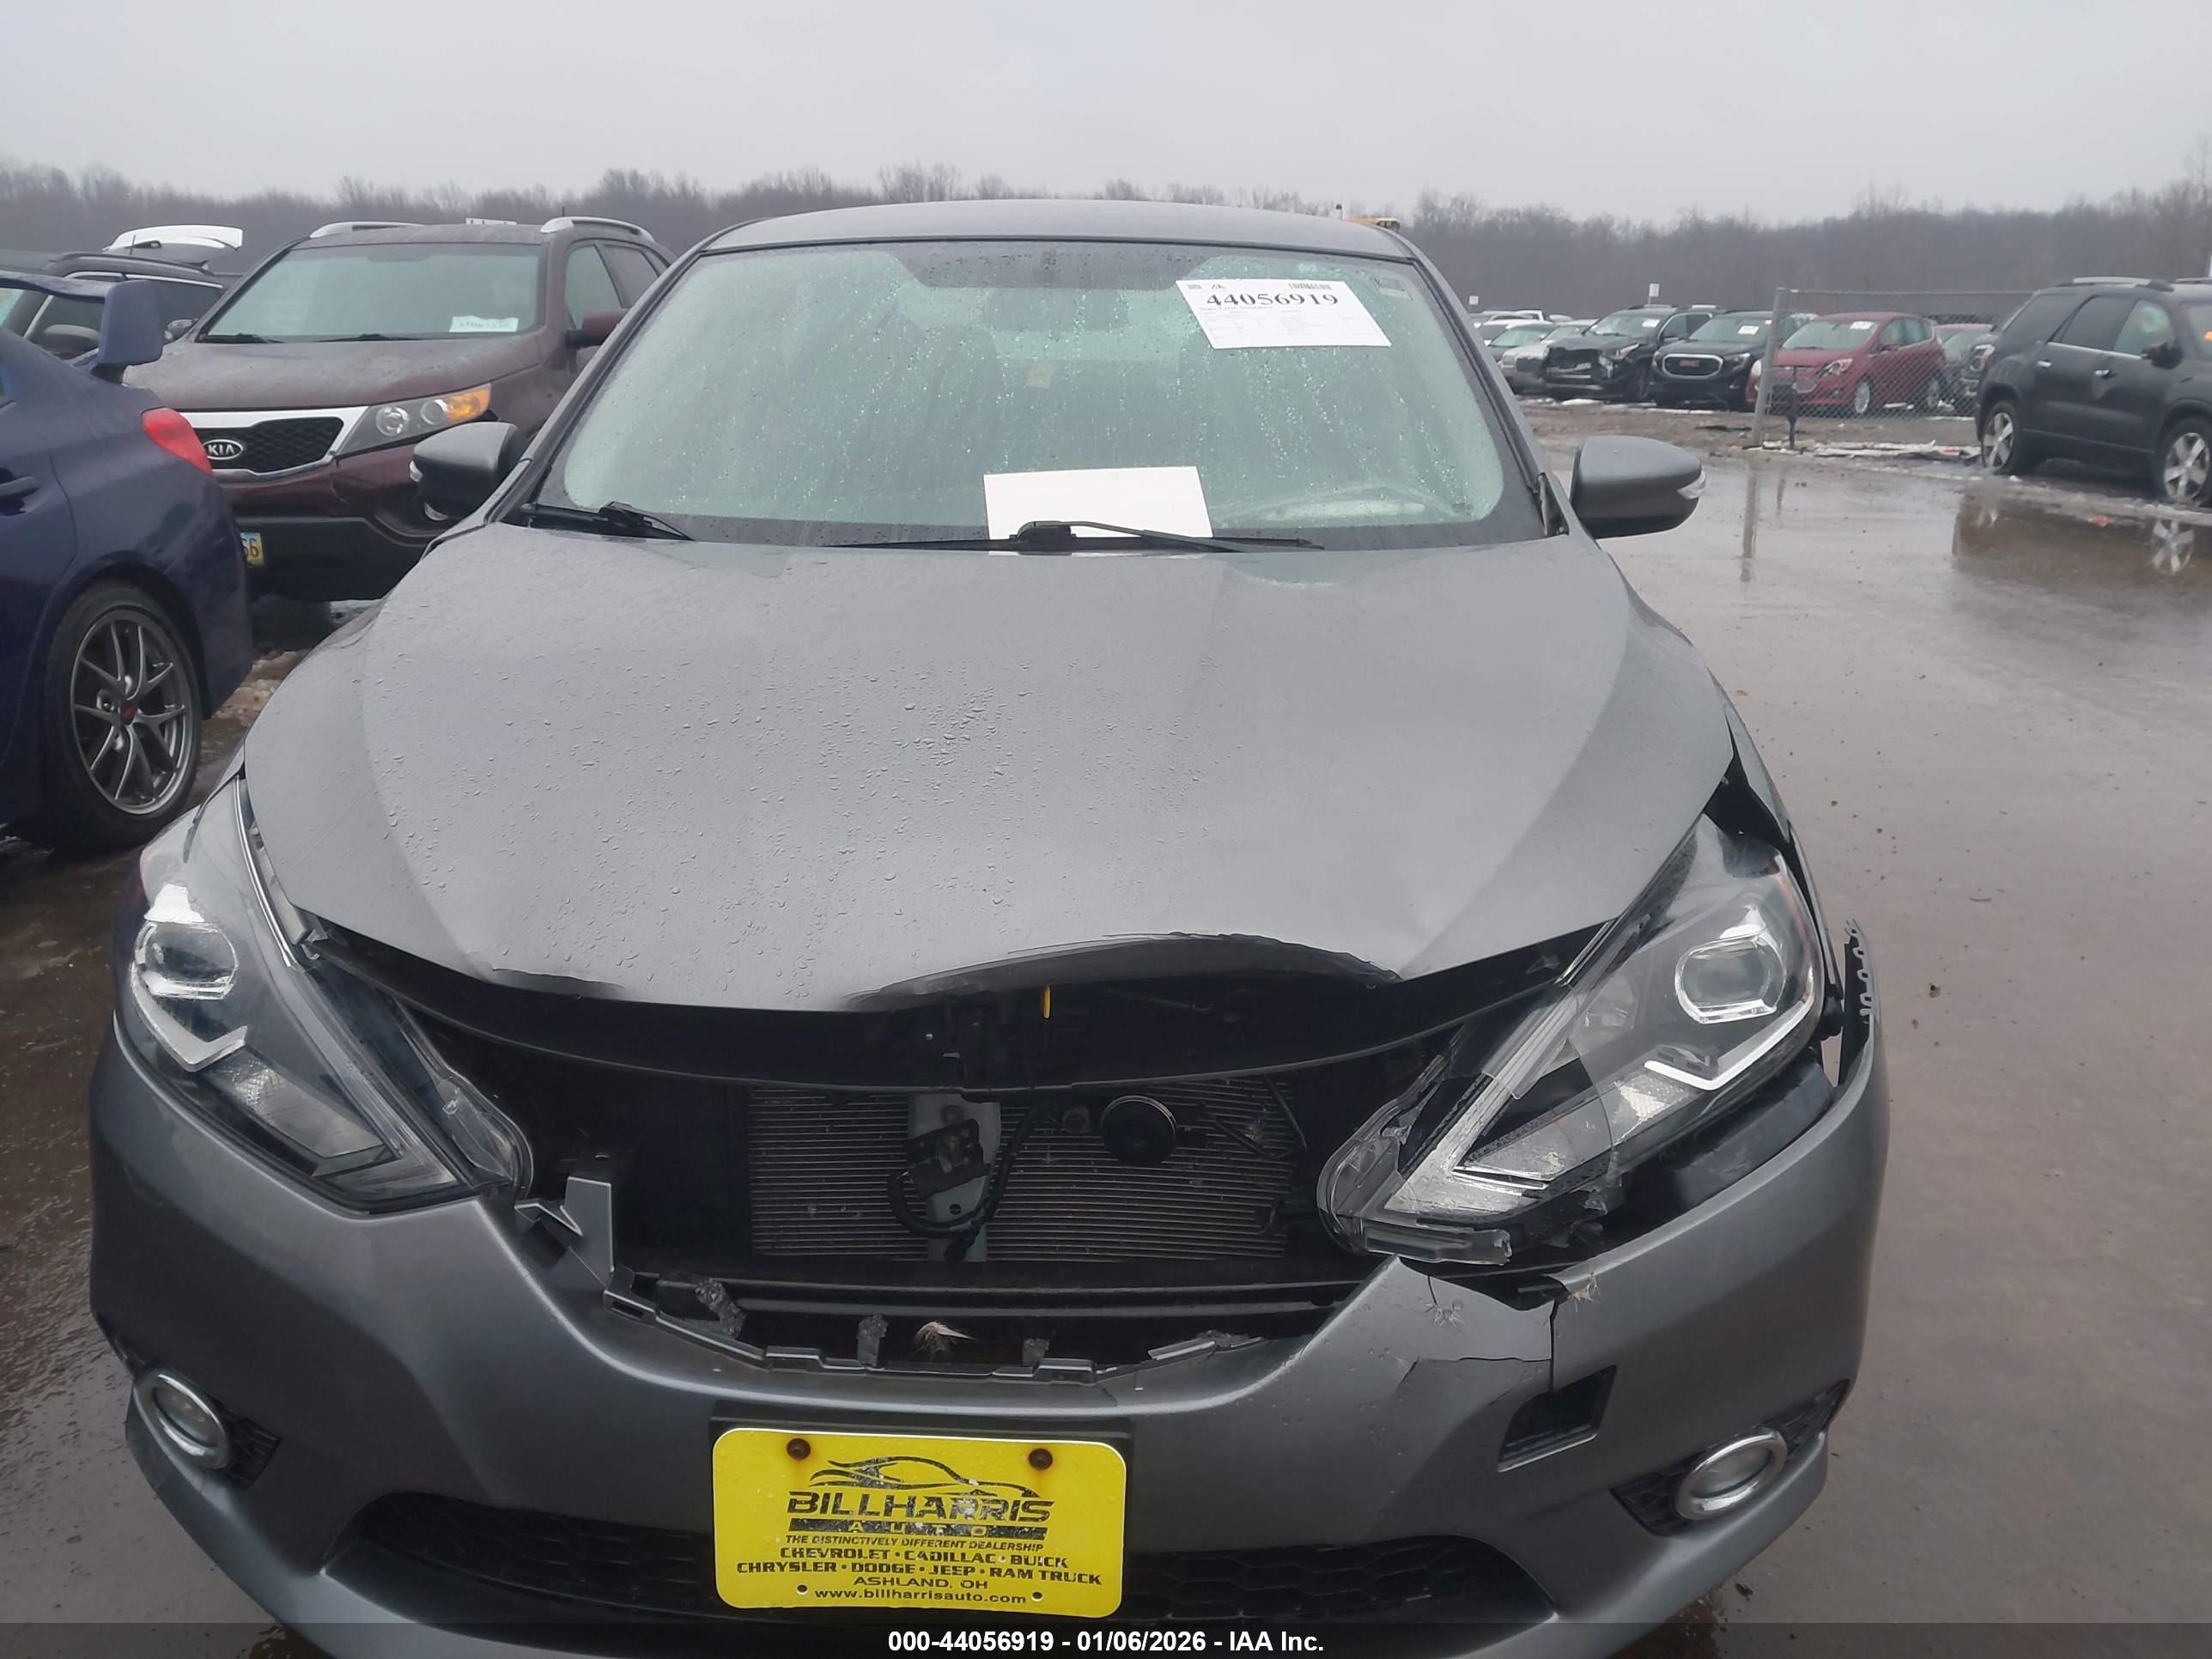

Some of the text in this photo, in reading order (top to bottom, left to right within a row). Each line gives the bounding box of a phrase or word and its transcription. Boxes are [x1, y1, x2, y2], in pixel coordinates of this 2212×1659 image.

[1206, 293, 1339, 306] 44056919
[208, 443, 235, 456] KIA
[848, 1521, 988, 1538] AUTO
[785, 1535, 1044, 1552] THE DISTINCTIVELY DIFFERENT DEALERSHIP
[780, 1547, 1068, 1569] CHEVROLET CADILLAC BUICK
[736, 1562, 1103, 1585] CHRYSLER DODGE JEEP RAM TRUCK
[960, 1579, 988, 1589] OH
[815, 1589, 1027, 1604] www.billharrisauto.com
